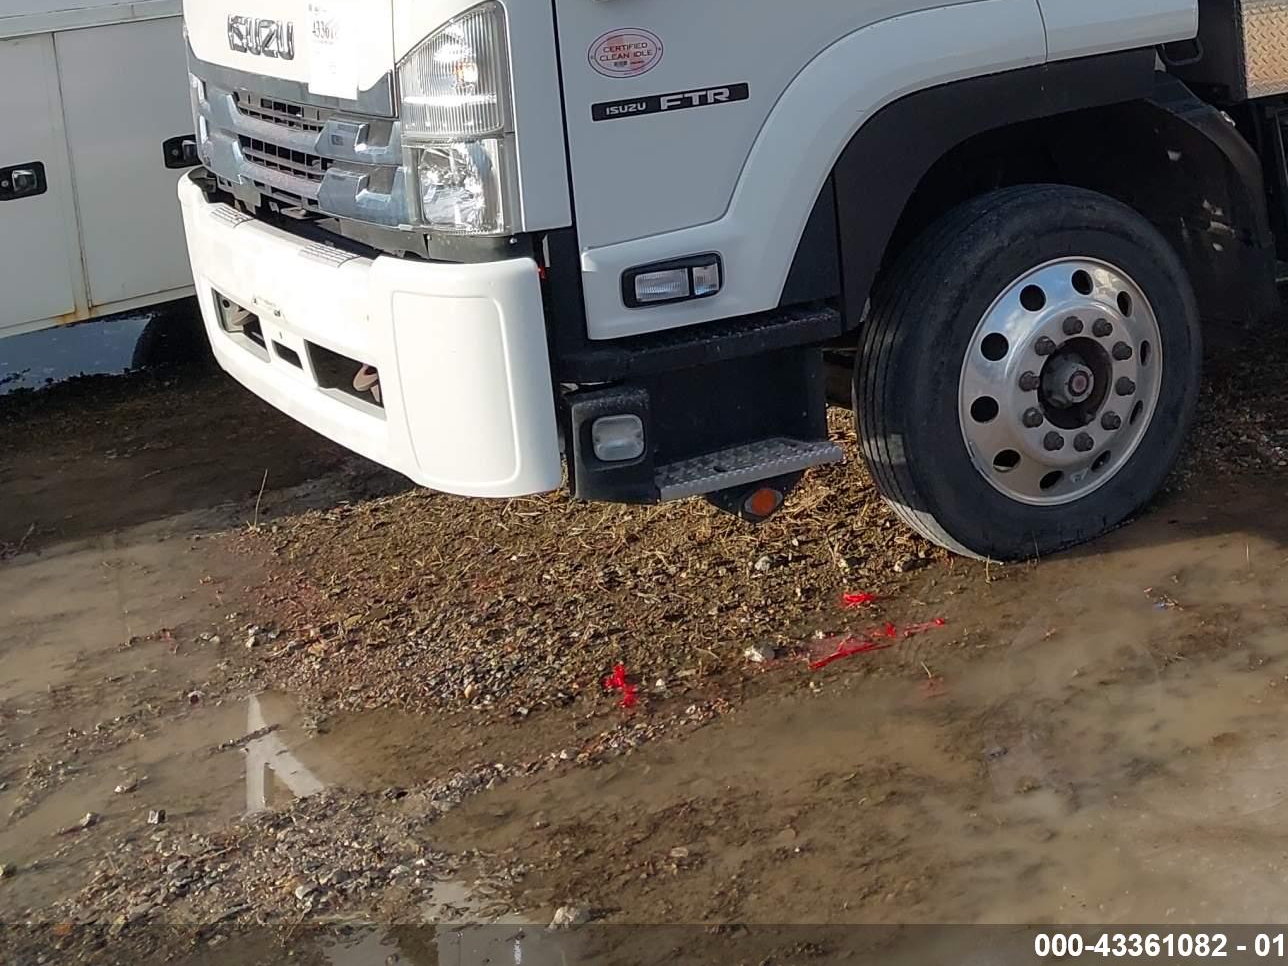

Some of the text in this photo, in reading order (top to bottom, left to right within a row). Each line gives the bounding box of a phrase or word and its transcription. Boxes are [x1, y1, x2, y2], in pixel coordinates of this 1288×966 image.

[227, 14, 295, 60] ISUZU
[600, 49, 653, 62] CLEAN IDLE
[603, 42, 648, 54] CERTIFIED
[606, 87, 730, 116] ISUZU FTR
